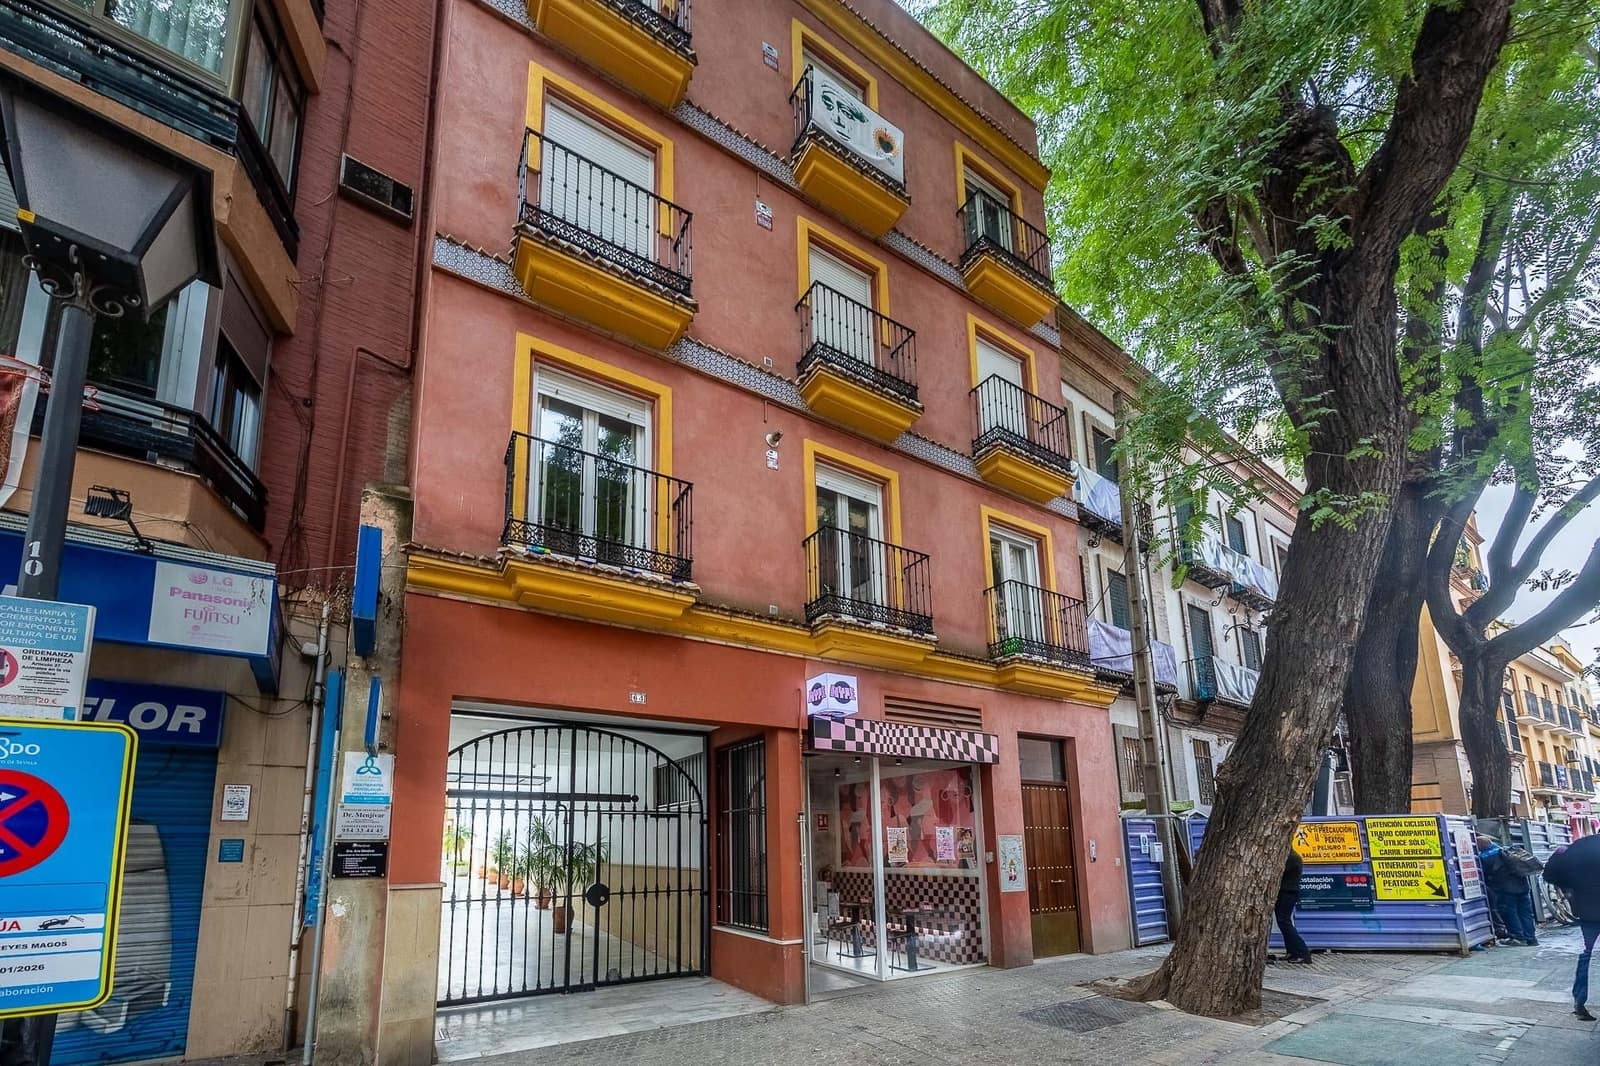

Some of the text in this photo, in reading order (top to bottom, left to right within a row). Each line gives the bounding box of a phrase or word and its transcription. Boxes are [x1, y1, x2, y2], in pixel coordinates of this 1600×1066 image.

[212, 576, 233, 587] LG
[169, 586, 257, 608] Panasonic
[0, 605, 32, 614] CALLE
[34, 608, 67, 618] LIMPIA
[184, 608, 240, 625] FUJITSU
[18, 622, 78, 634] EXPONENTE
[0, 627, 42, 638] ULTURA
[45, 632, 59, 640] DE
[22, 648, 74, 658] ORDENANZA
[35, 656, 73, 664] LIMPIEZA
[1394, 829, 1437, 837] COMPARTIDO
[1379, 848, 1433, 856] CARRIL DERECHO
[1378, 861, 1418, 869] ITINERARIO
[1376, 870, 1424, 878] PROVISIONAL
[1383, 879, 1420, 887] PEATONES
[31, 941, 68, 949] MAGOS
[0, 964, 45, 974] 01/2026
